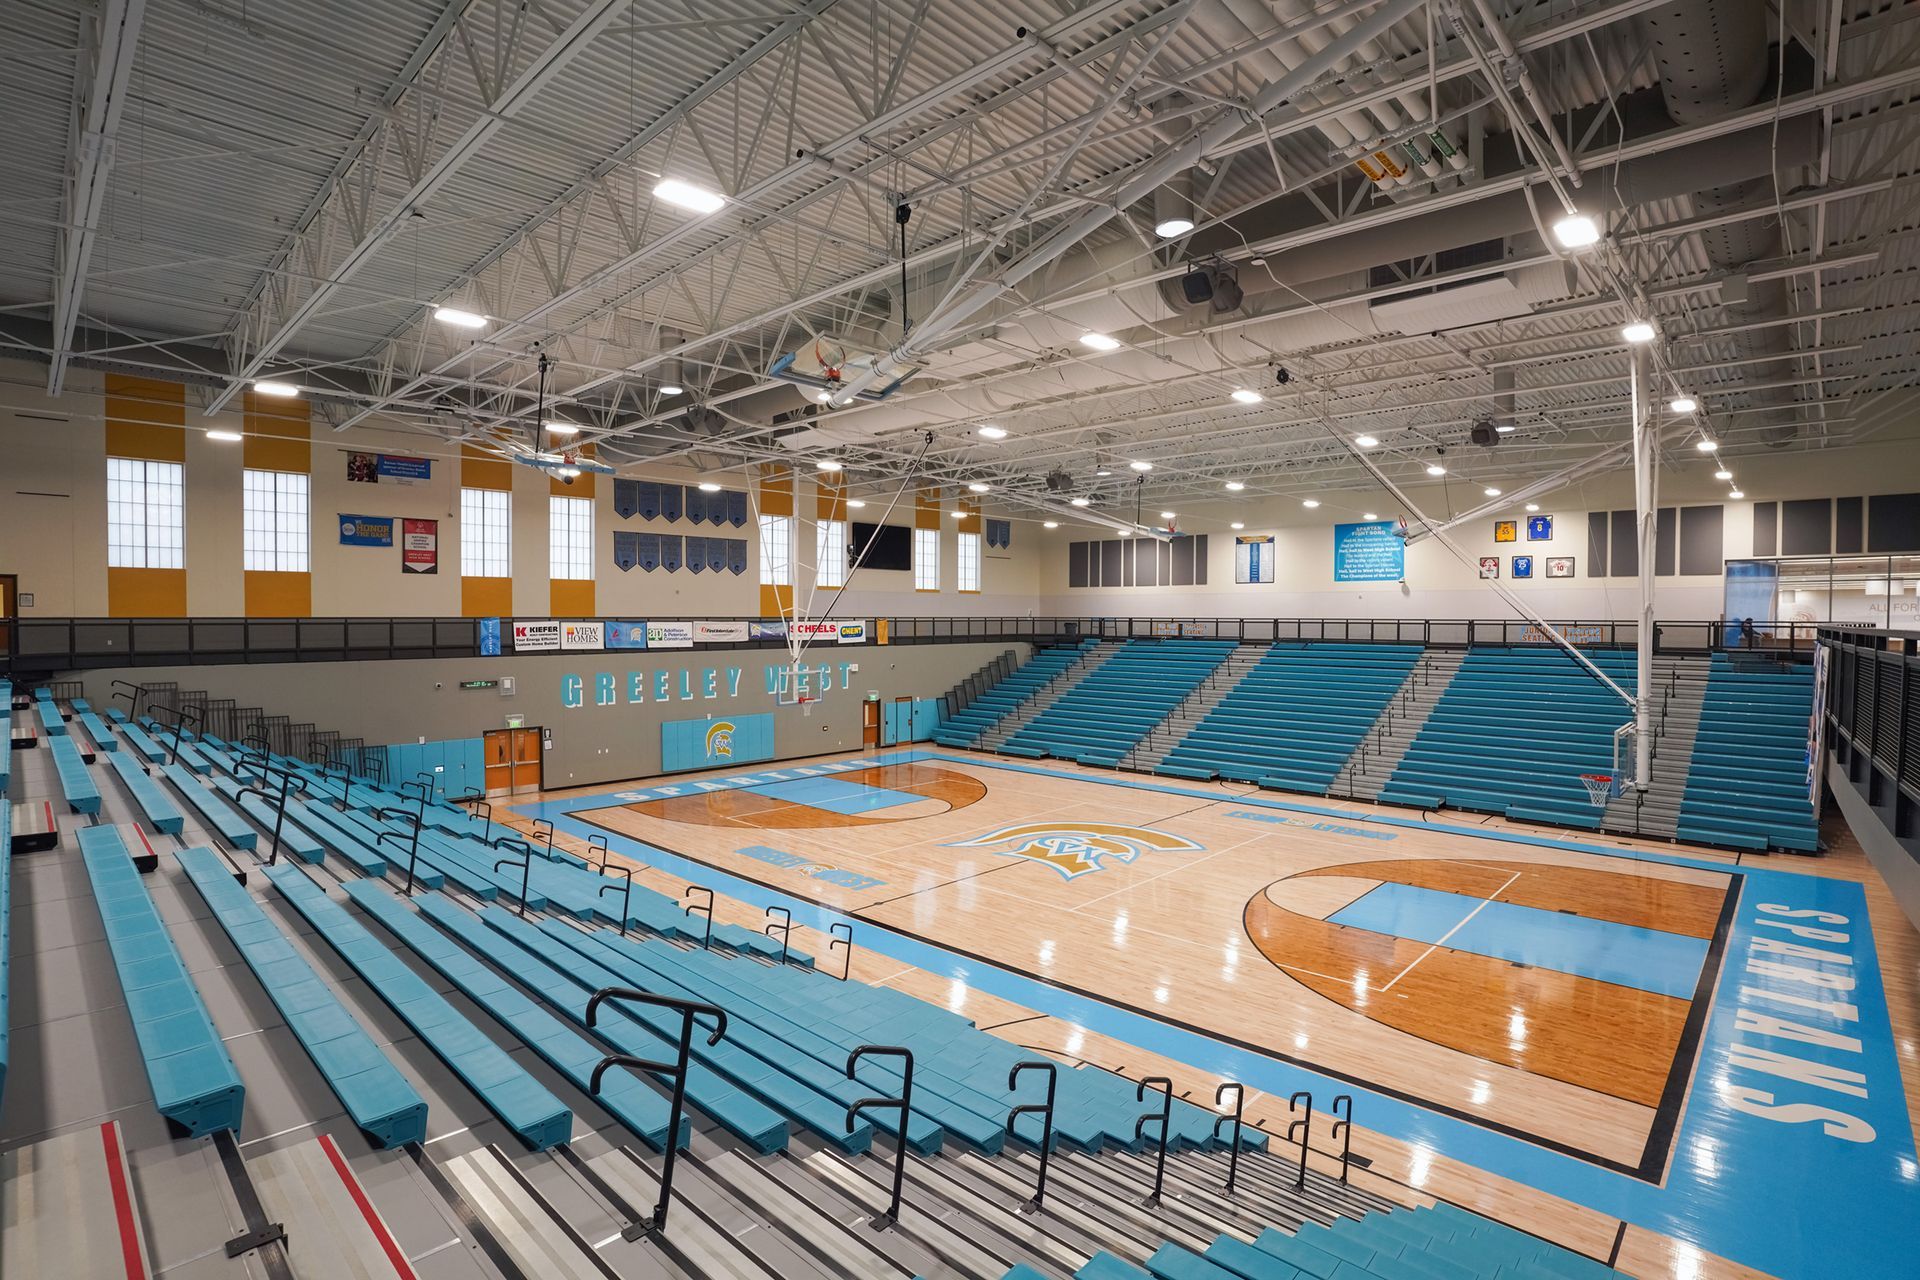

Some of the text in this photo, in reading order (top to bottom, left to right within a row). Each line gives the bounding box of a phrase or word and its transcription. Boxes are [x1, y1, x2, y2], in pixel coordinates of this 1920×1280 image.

[356, 524, 389, 532] HONOR
[1893, 603, 1917, 612] FOR
[574, 627, 599, 635] VIEW
[790, 624, 837, 633] SCHEELS
[566, 635, 599, 643] HOMES
[561, 662, 851, 708] GREELEY WEST
[613, 759, 883, 801] SPARTANS
[1719, 903, 1877, 1144] SPARTANS
